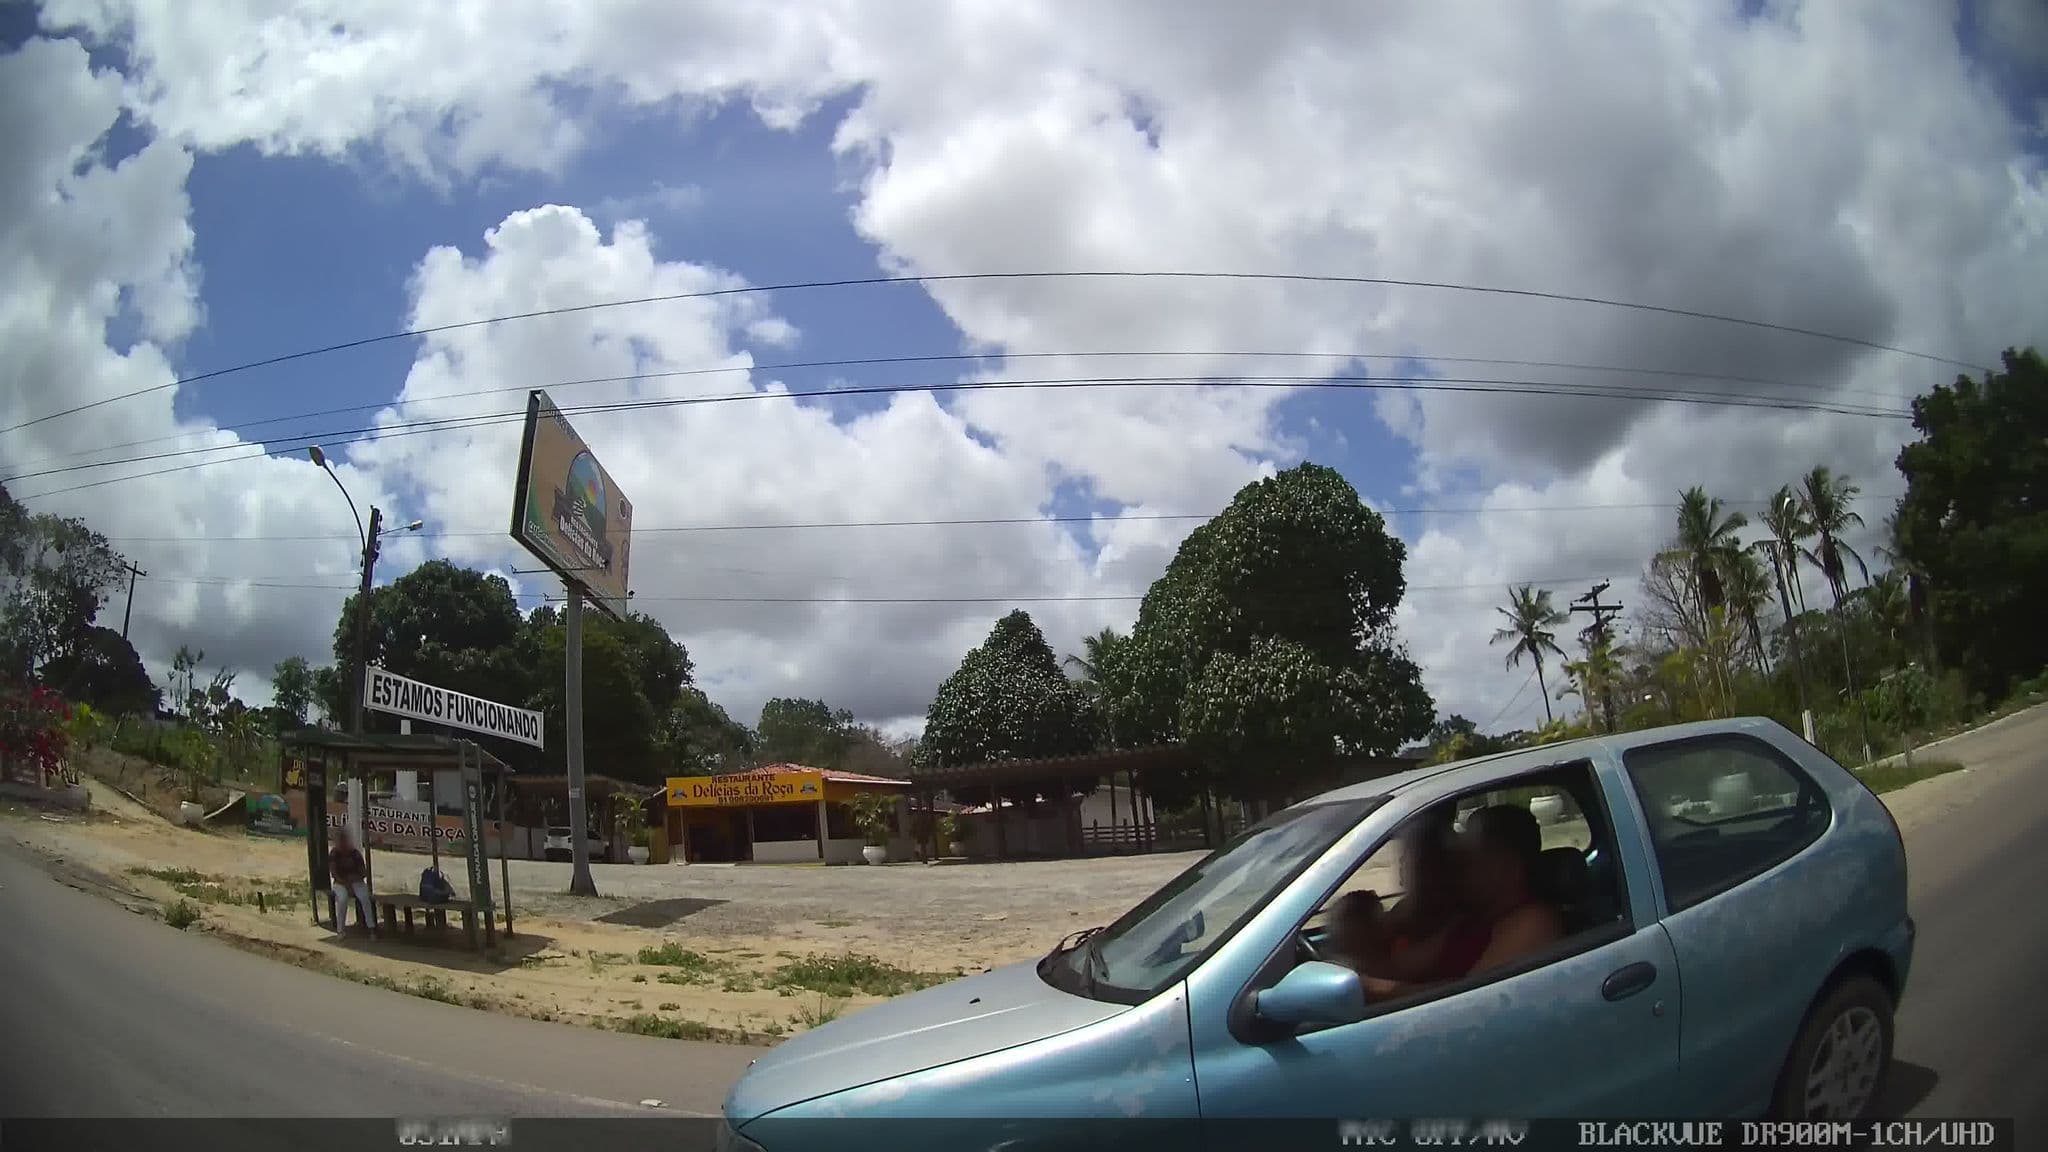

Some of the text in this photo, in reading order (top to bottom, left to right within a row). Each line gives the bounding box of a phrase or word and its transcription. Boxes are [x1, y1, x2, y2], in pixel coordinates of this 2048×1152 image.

[372, 674, 538, 741] ESTAMOS FUNCIONANDO
[711, 773, 776, 784] RESTAURANTE
[744, 781, 758, 795] da
[762, 781, 793, 798] Roça
[394, 822, 416, 836] DA
[421, 826, 465, 842] ROÇA
